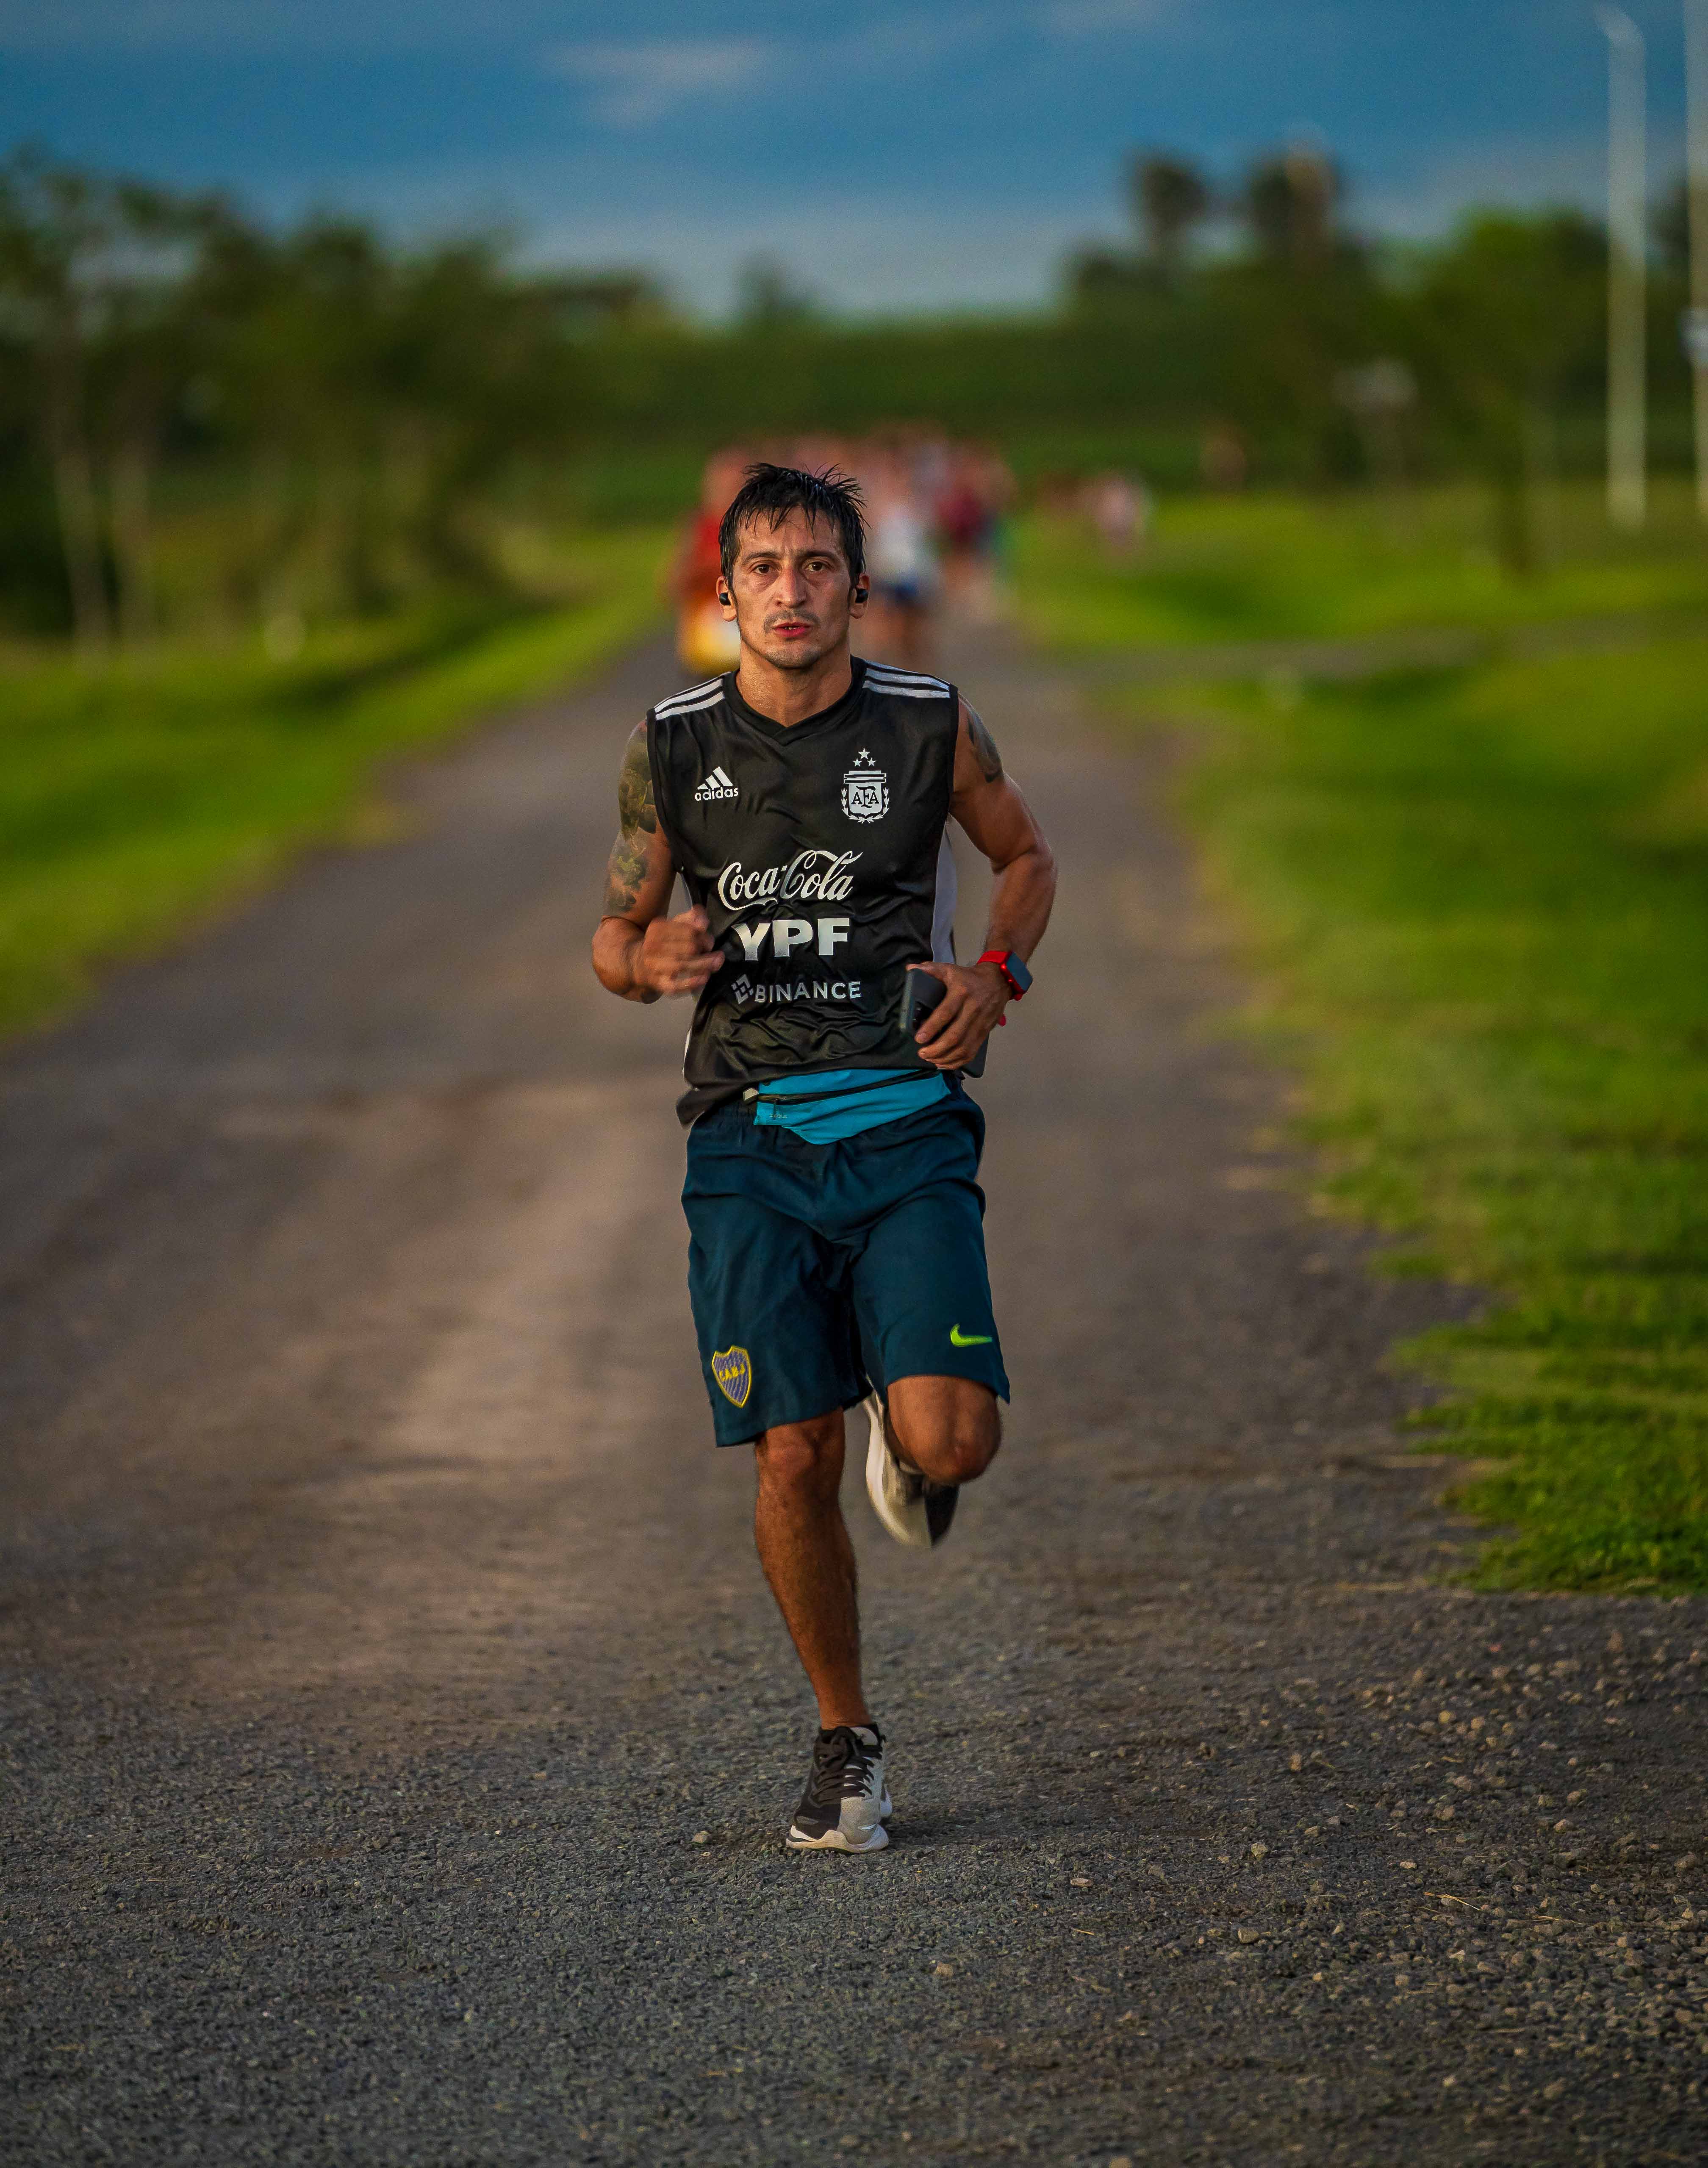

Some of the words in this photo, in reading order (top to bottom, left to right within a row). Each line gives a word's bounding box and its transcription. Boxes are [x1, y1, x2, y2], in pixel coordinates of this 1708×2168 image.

[695, 787, 738, 801] adidas
[851, 785, 879, 809] AFA
[731, 918, 850, 961] YPF
[754, 981, 862, 1003] BINANCE
